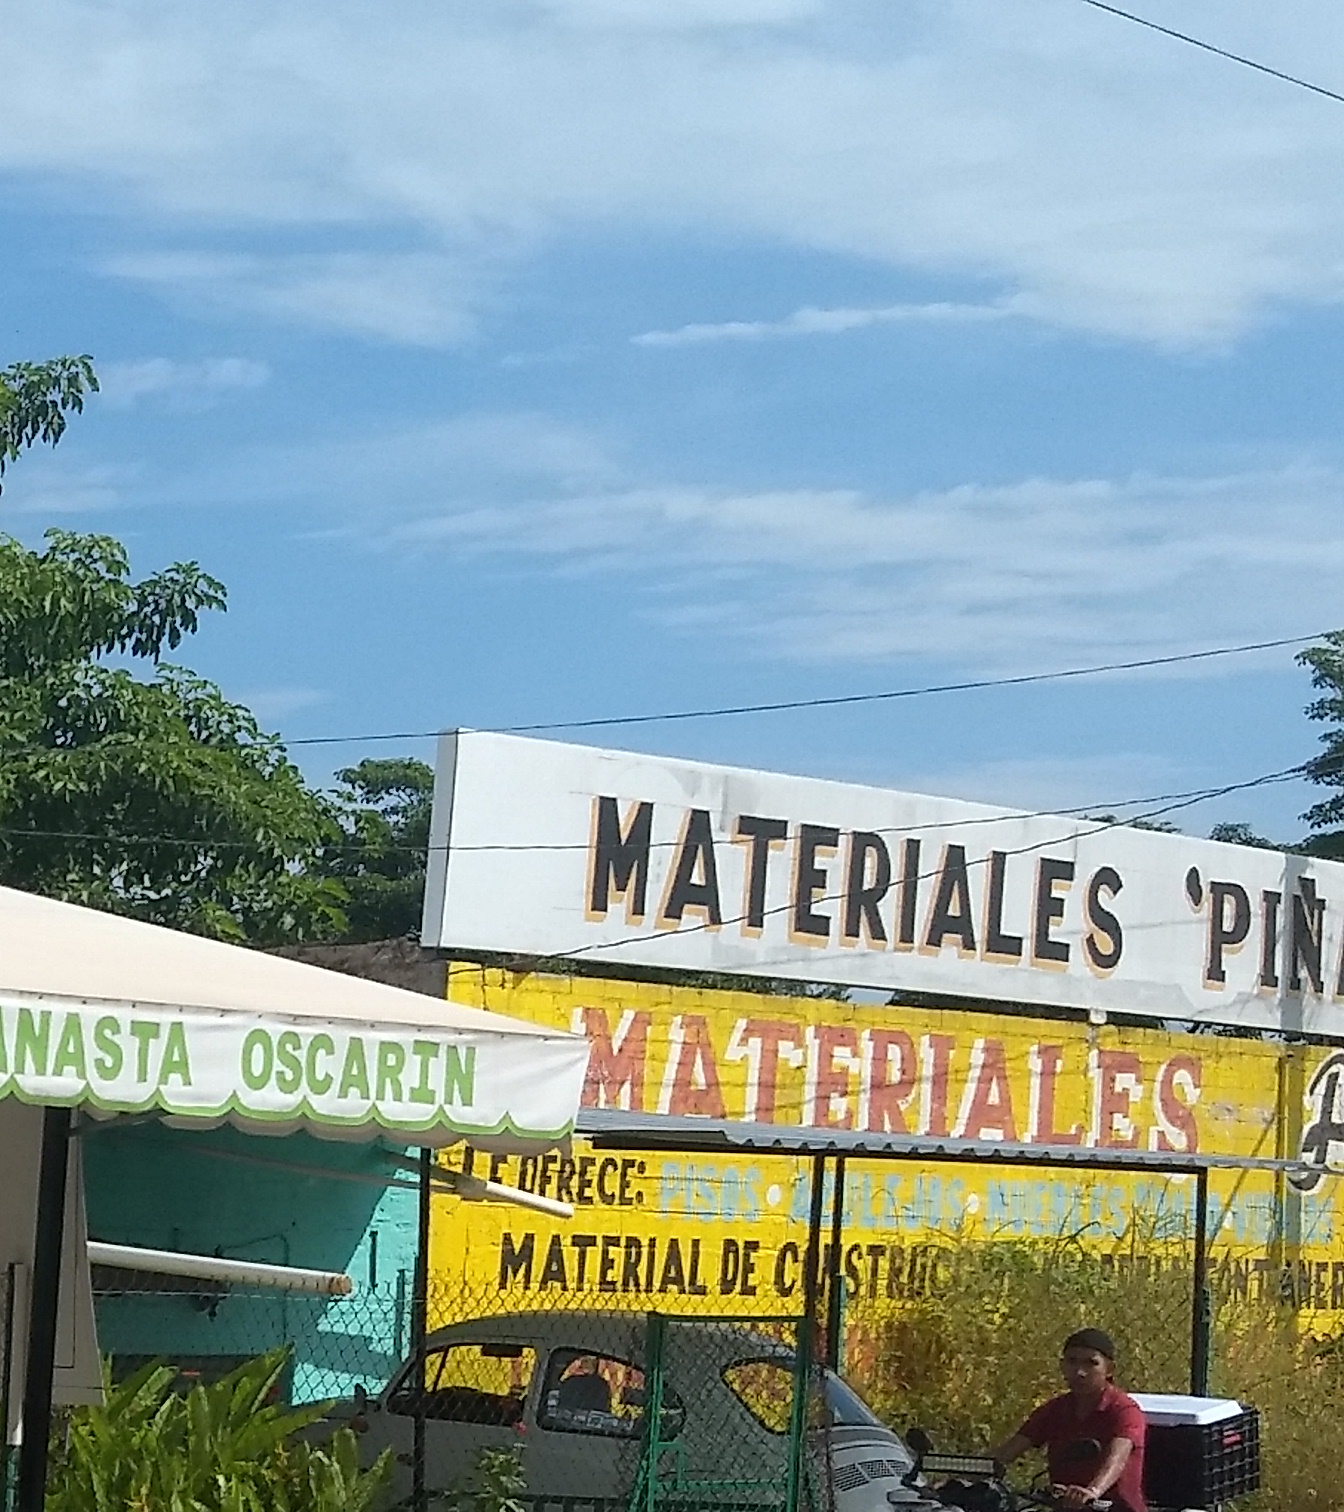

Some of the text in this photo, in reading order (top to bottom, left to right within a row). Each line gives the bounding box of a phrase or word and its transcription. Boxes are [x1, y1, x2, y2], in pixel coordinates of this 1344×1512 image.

[585, 795, 1124, 980] MATERIALES
[241, 1027, 477, 1109] OSCARIN
[574, 1006, 1204, 1154] MATERIALES
[499, 1231, 707, 1296] MATERIAL
[720, 1240, 762, 1297] DE
